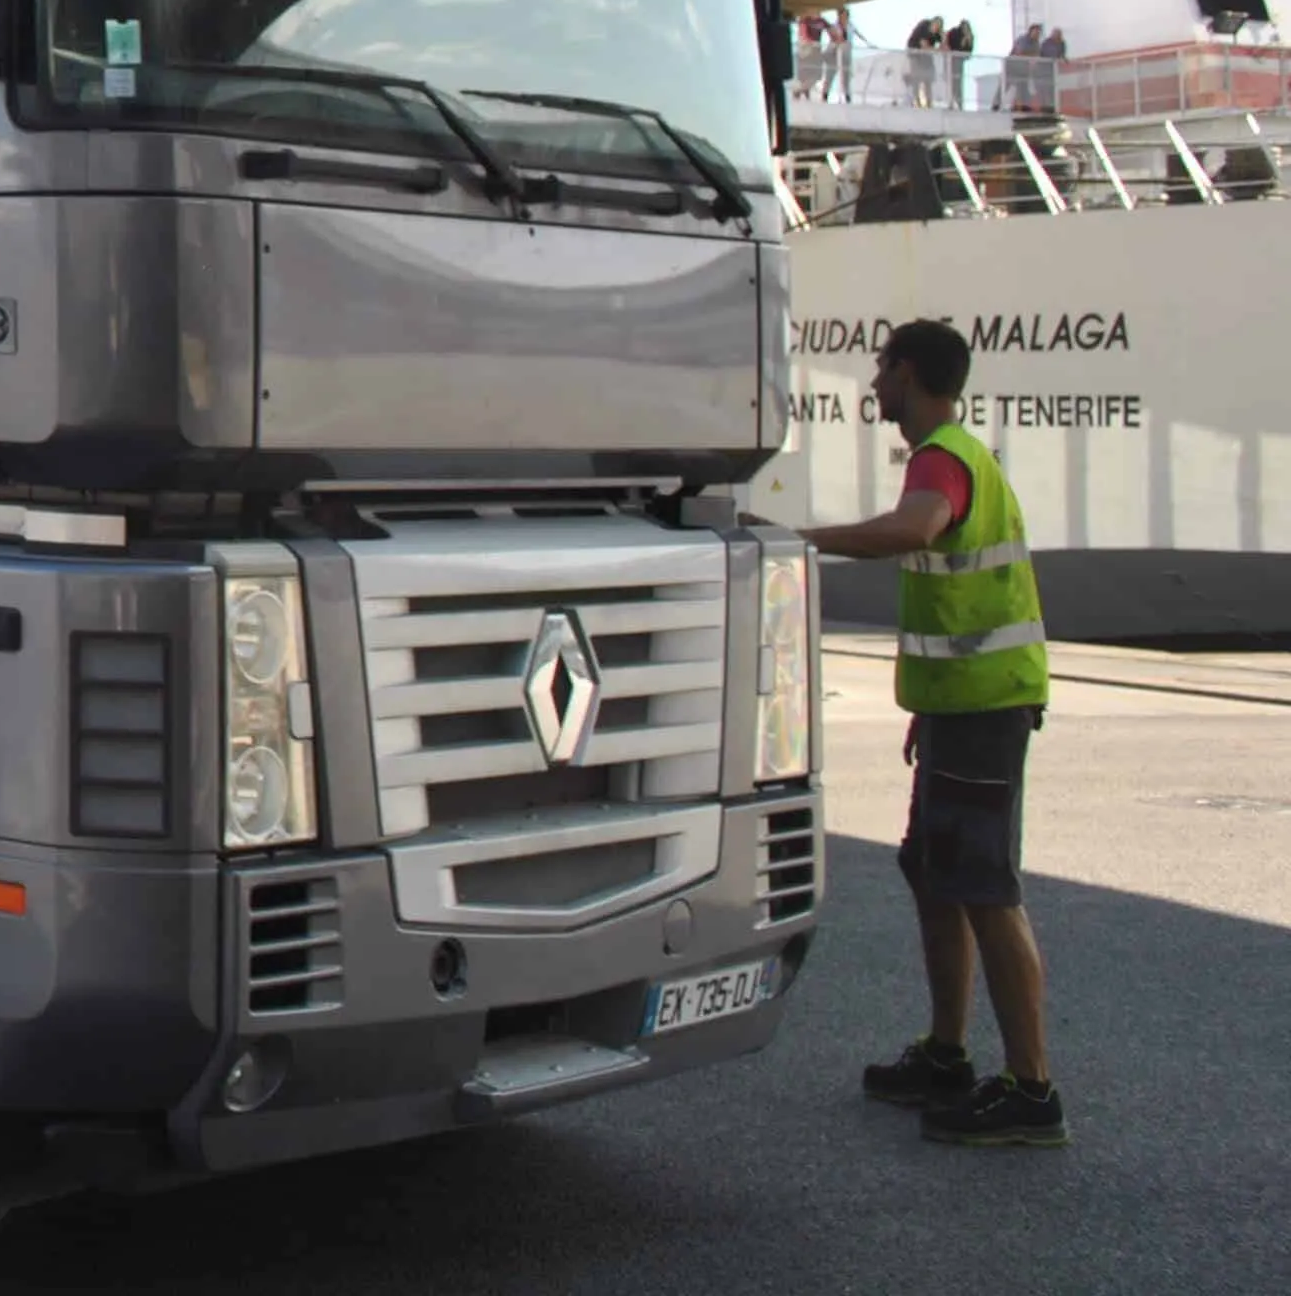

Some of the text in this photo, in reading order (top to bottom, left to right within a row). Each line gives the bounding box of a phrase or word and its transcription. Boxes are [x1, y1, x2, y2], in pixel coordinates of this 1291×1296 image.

[970, 312, 1130, 352] MALAGA
[788, 392, 846, 423] ANTA
[996, 395, 1142, 428] TENERIFE
